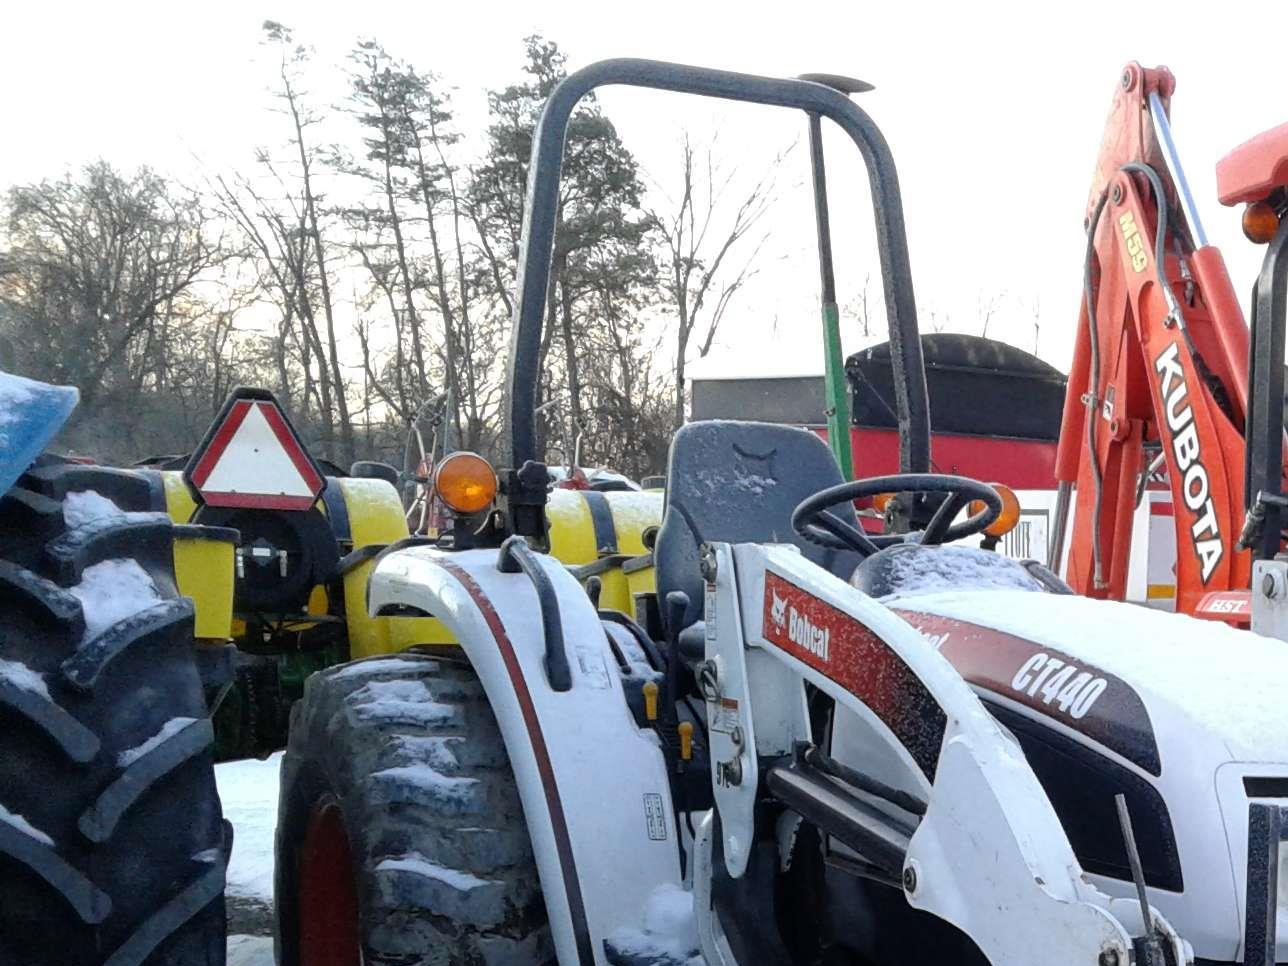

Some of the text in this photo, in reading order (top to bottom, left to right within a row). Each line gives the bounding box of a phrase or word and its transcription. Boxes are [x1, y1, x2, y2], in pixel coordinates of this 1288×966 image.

[1117, 212, 1148, 273] M59
[1156, 343, 1223, 584] KUBOTA
[788, 606, 829, 661] Bobcat
[1011, 653, 1108, 719] CT440
